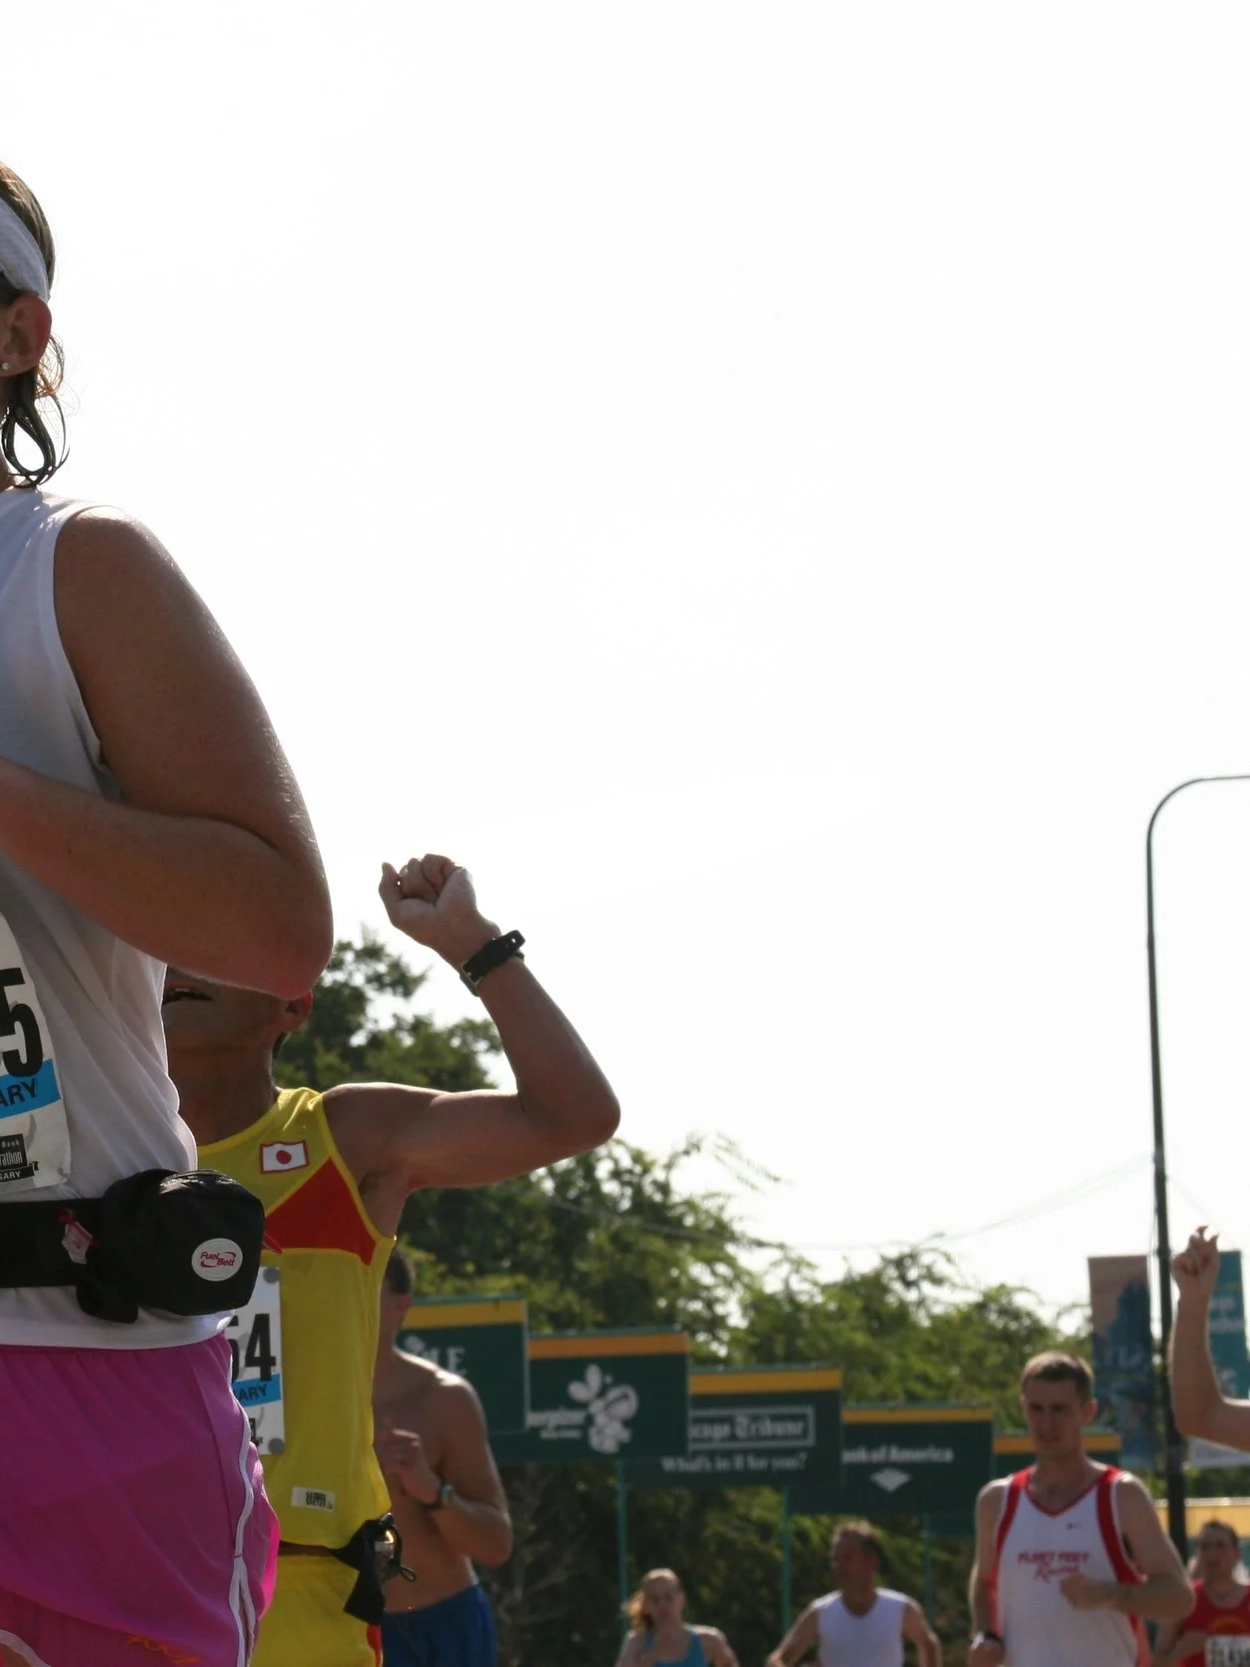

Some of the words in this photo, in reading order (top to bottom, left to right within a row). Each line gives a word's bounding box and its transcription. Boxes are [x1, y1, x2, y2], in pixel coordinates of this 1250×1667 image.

[2, 1140, 20, 1148] Bank
[200, 1251, 220, 1260] Fuel
[217, 1258, 235, 1267] Belt
